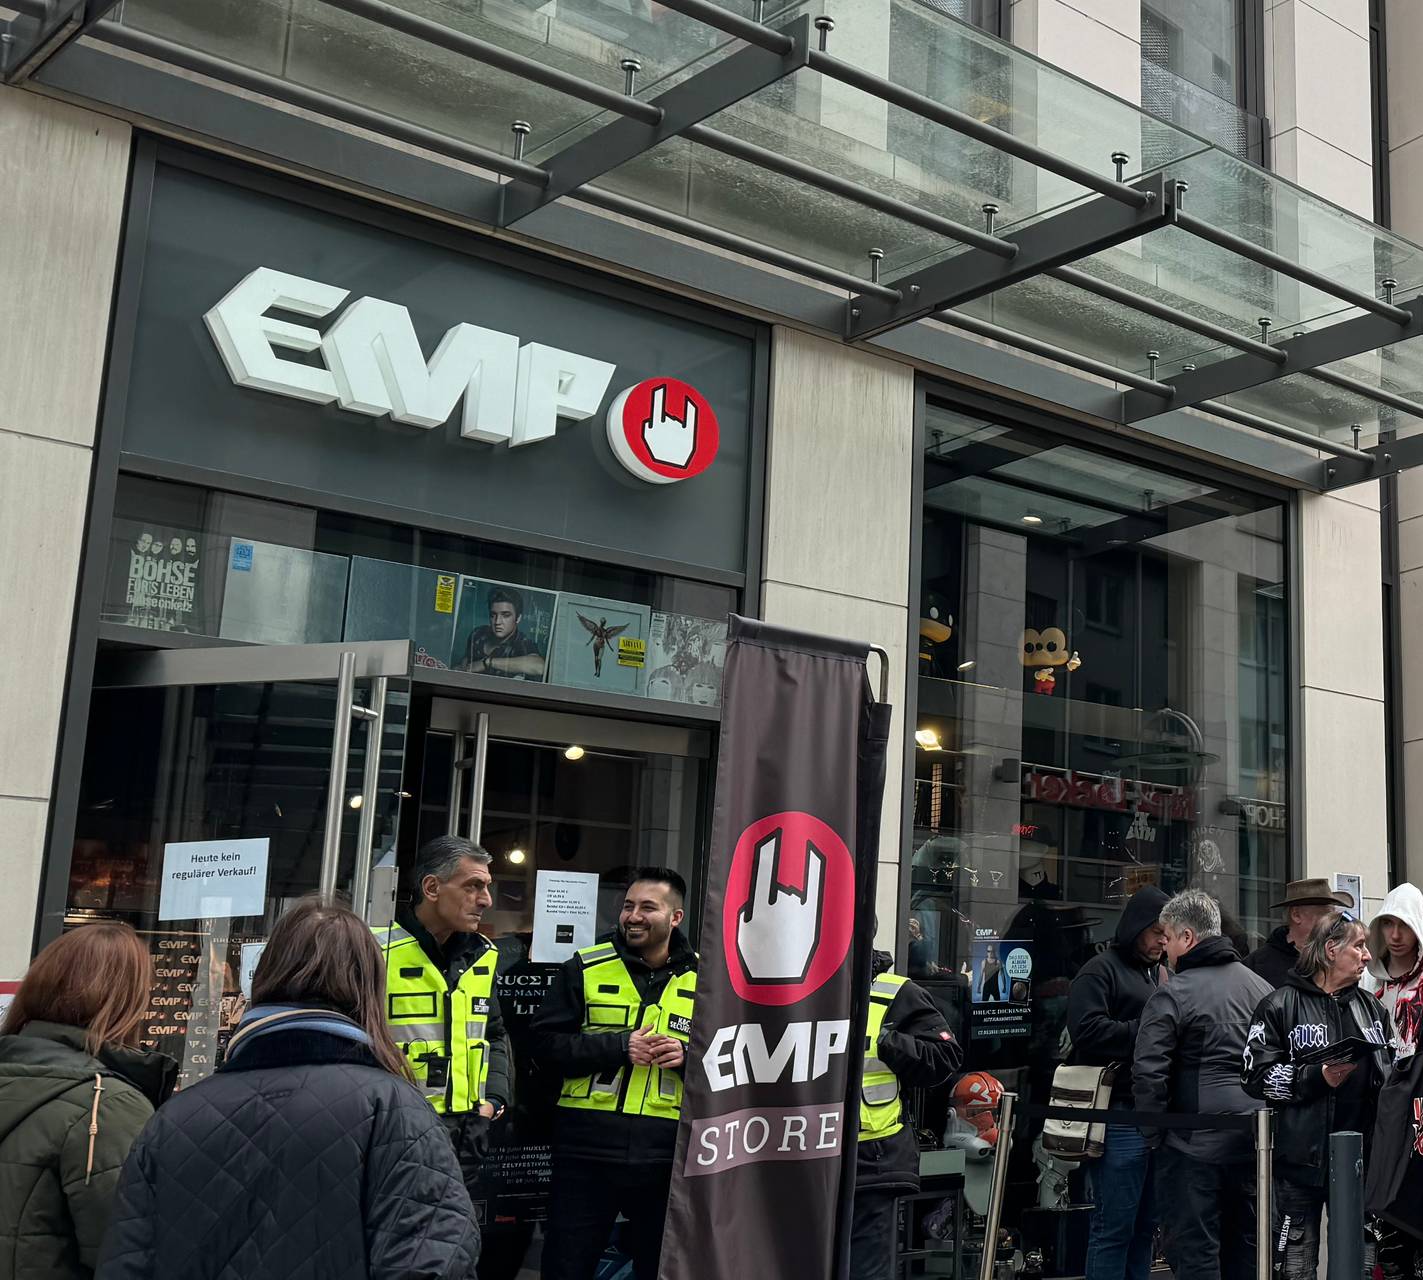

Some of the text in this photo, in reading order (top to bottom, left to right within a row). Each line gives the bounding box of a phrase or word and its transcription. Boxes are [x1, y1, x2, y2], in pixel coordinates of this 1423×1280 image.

[203, 267, 616, 448] EMP
[129, 550, 199, 587] BÖHSE
[160, 582, 195, 602] LEBEN
[191, 852, 241, 863] Heute kein
[171, 866, 257, 881] regulärer Verkauf!
[158, 940, 188, 949] EMP
[156, 968, 185, 977] EMP
[151, 997, 182, 1006] EMP
[147, 1025, 179, 1035] EMP
[701, 1019, 850, 1093] EMP
[696, 1111, 840, 1167] STORE
